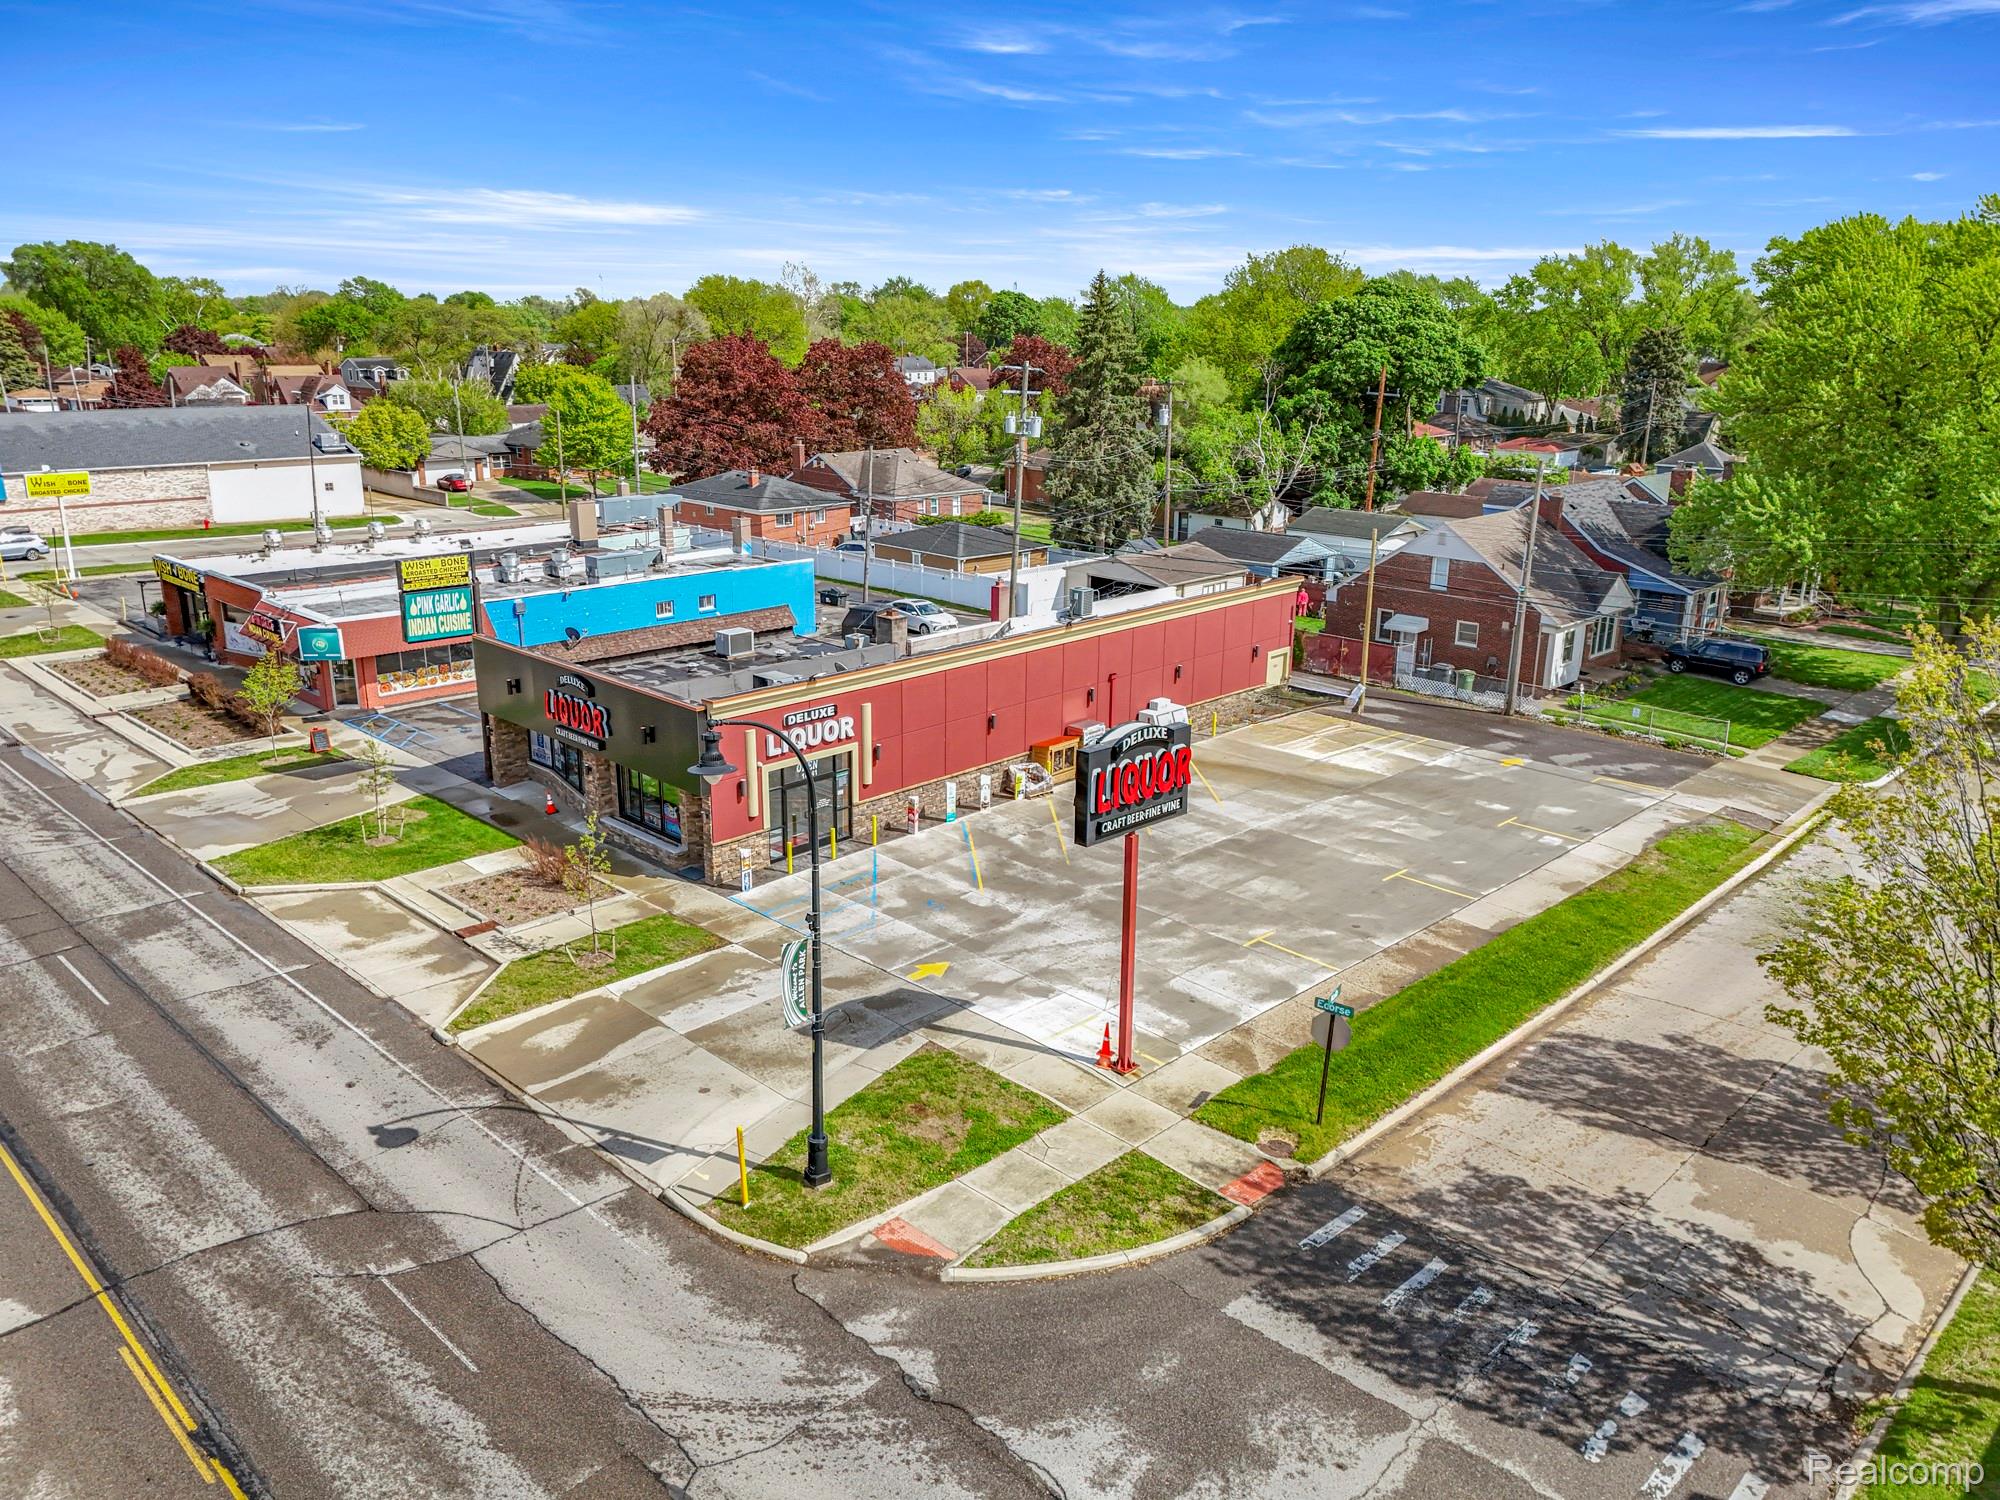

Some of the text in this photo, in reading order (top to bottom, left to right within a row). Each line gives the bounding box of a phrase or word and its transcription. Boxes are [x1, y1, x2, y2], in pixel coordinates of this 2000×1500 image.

[30, 477, 56, 487] WISH
[405, 557, 465, 570] WISH BONE
[406, 568, 438, 576] BROASTED
[178, 567, 199, 585] BONE
[417, 592, 459, 615] PINK GARLIC
[408, 612, 471, 637] INDIAN CUISINE
[560, 675, 585, 692] DELUXE
[544, 689, 608, 738] LIQUOR
[788, 706, 835, 725] DELUXE
[766, 716, 855, 757] LIQUOR
[1122, 727, 1168, 752] DELUXE
[1094, 745, 1192, 815] LIQUOR
[1102, 815, 1126, 833] CRAFT
[1162, 799, 1181, 814] WINE
[798, 950, 806, 1008] ALLEN PARK
[1317, 999, 1351, 1016] Ecorse
